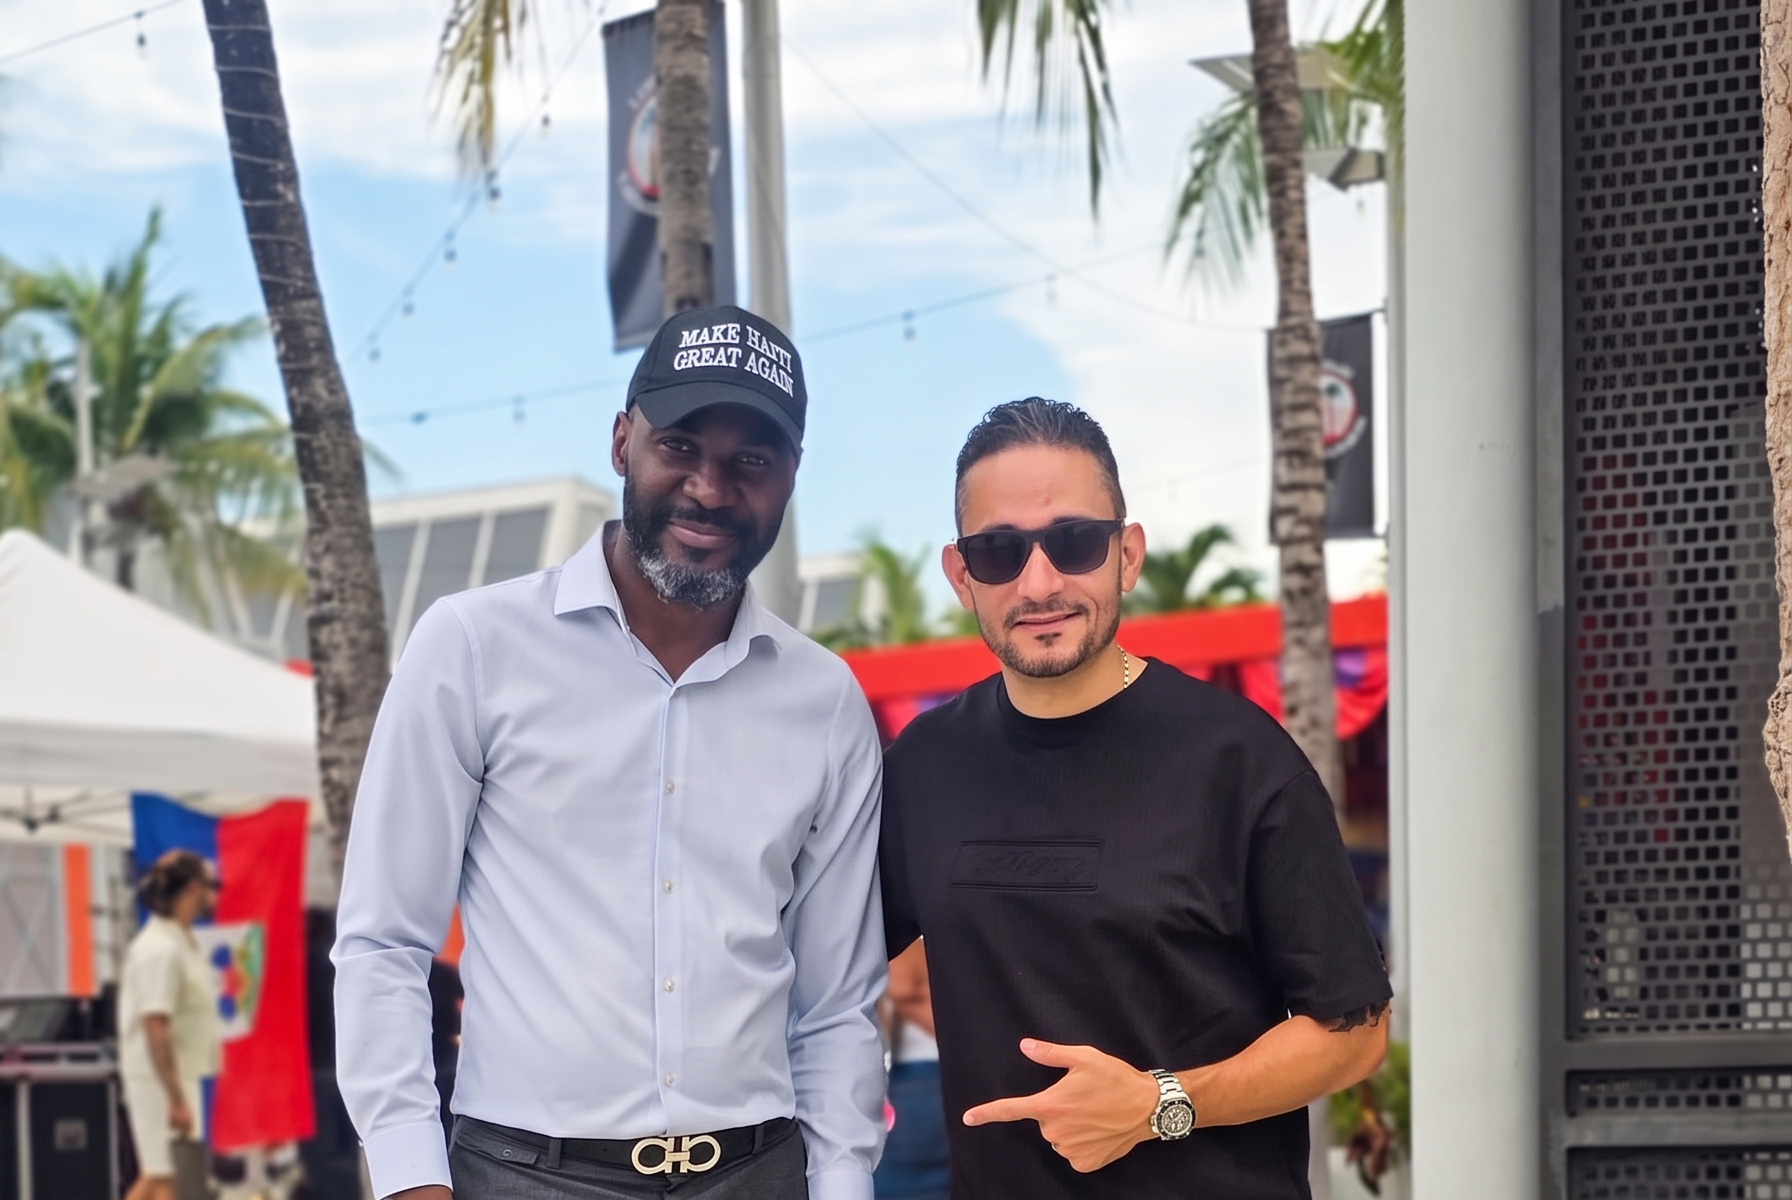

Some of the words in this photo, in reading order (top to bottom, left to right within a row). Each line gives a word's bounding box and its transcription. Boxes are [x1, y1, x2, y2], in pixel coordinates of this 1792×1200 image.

[673, 346, 742, 371] GREAT
[744, 351, 793, 398] AGAIN
[678, 323, 741, 348] MAKE
[746, 325, 792, 373] HAITI
